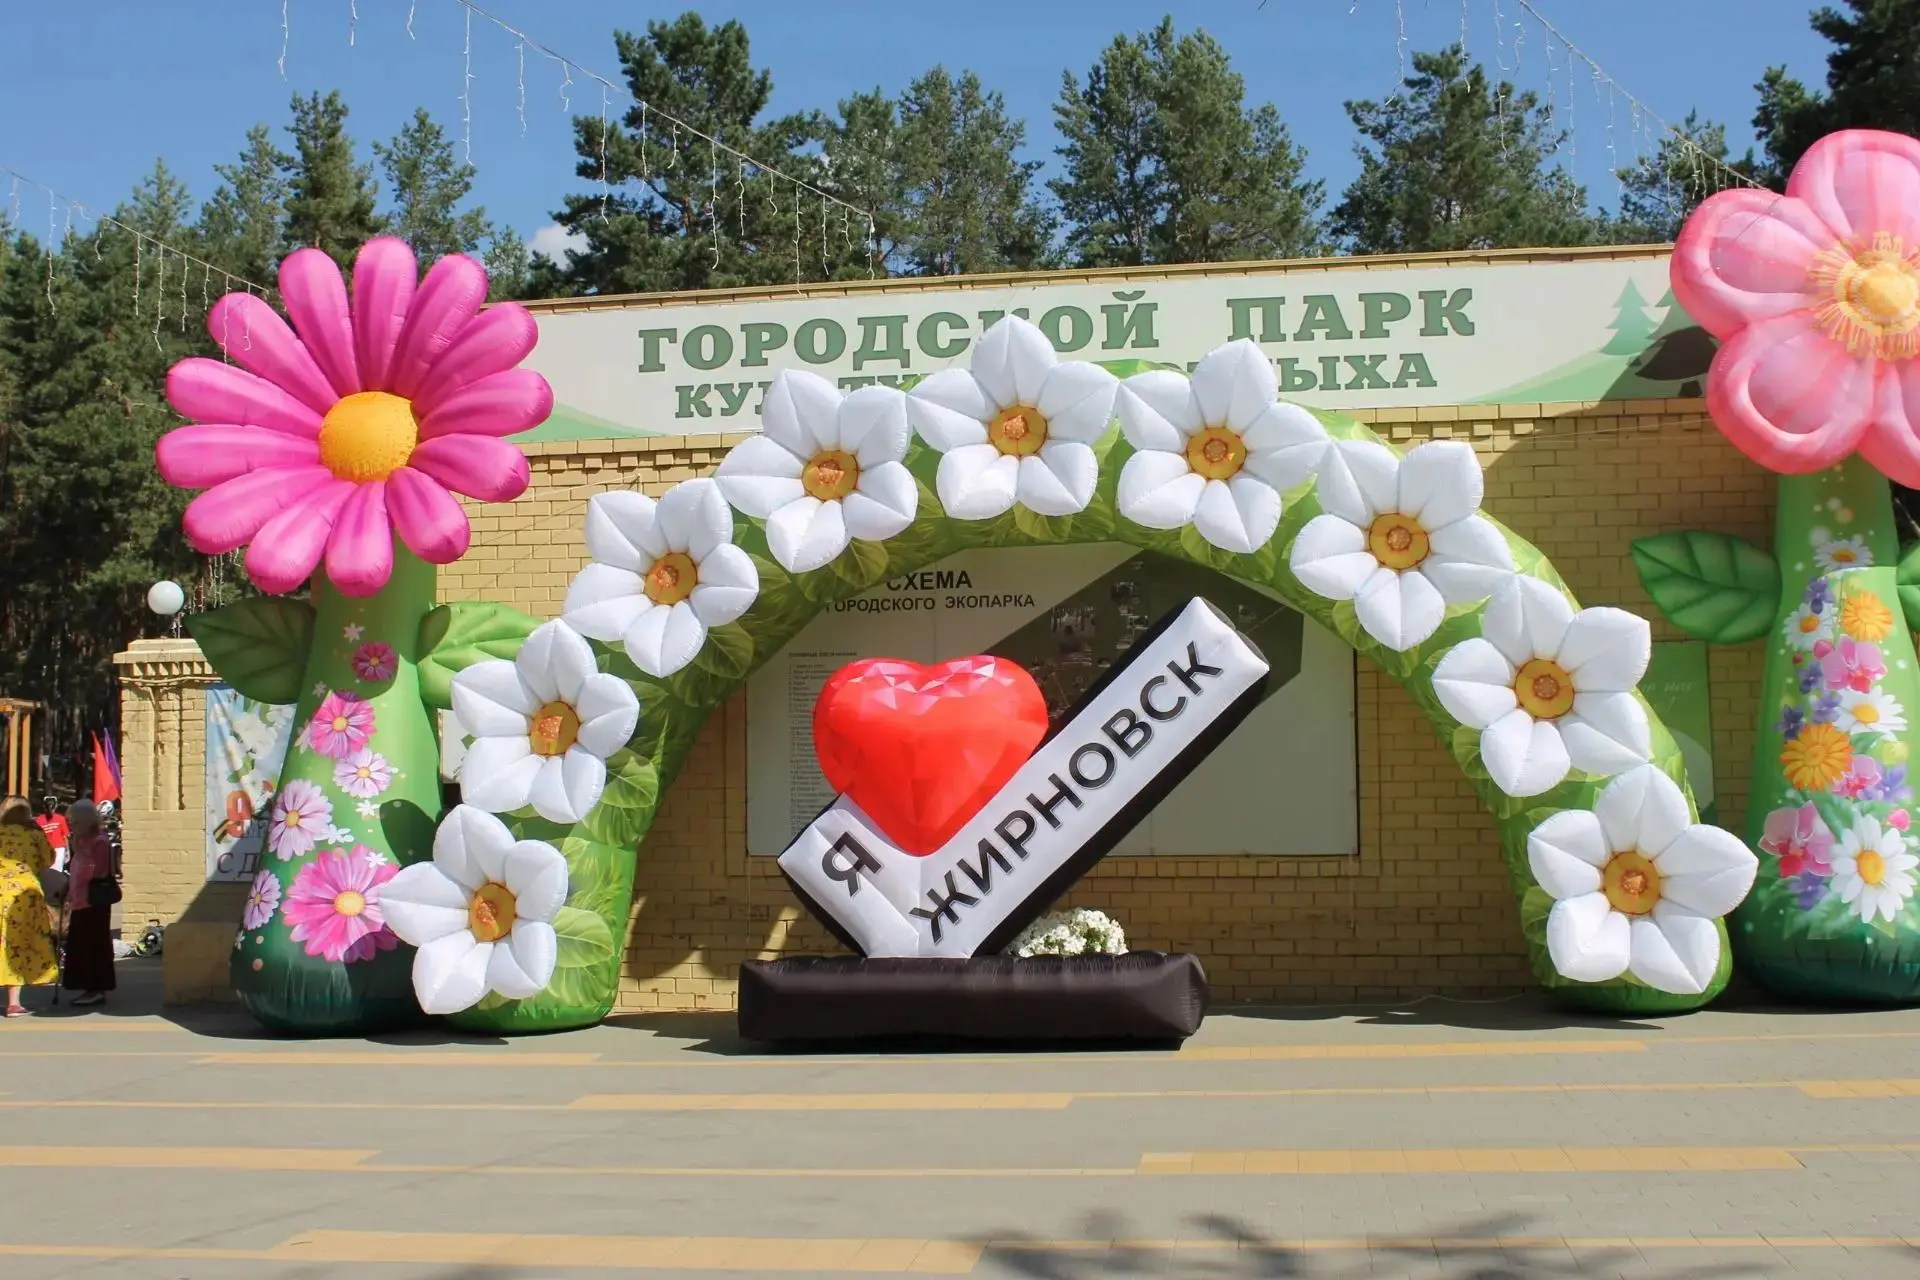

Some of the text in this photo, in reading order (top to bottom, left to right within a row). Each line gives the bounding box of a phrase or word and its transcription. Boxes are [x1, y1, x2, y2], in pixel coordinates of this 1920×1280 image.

[1226, 288, 1475, 342] ПАРК
[1160, 352, 1438, 393] ЫХА
[945, 594, 1036, 609] ЭКОПАРКА
[908, 640, 1223, 945] ЖИРНОВСК
[821, 831, 882, 898] Я
